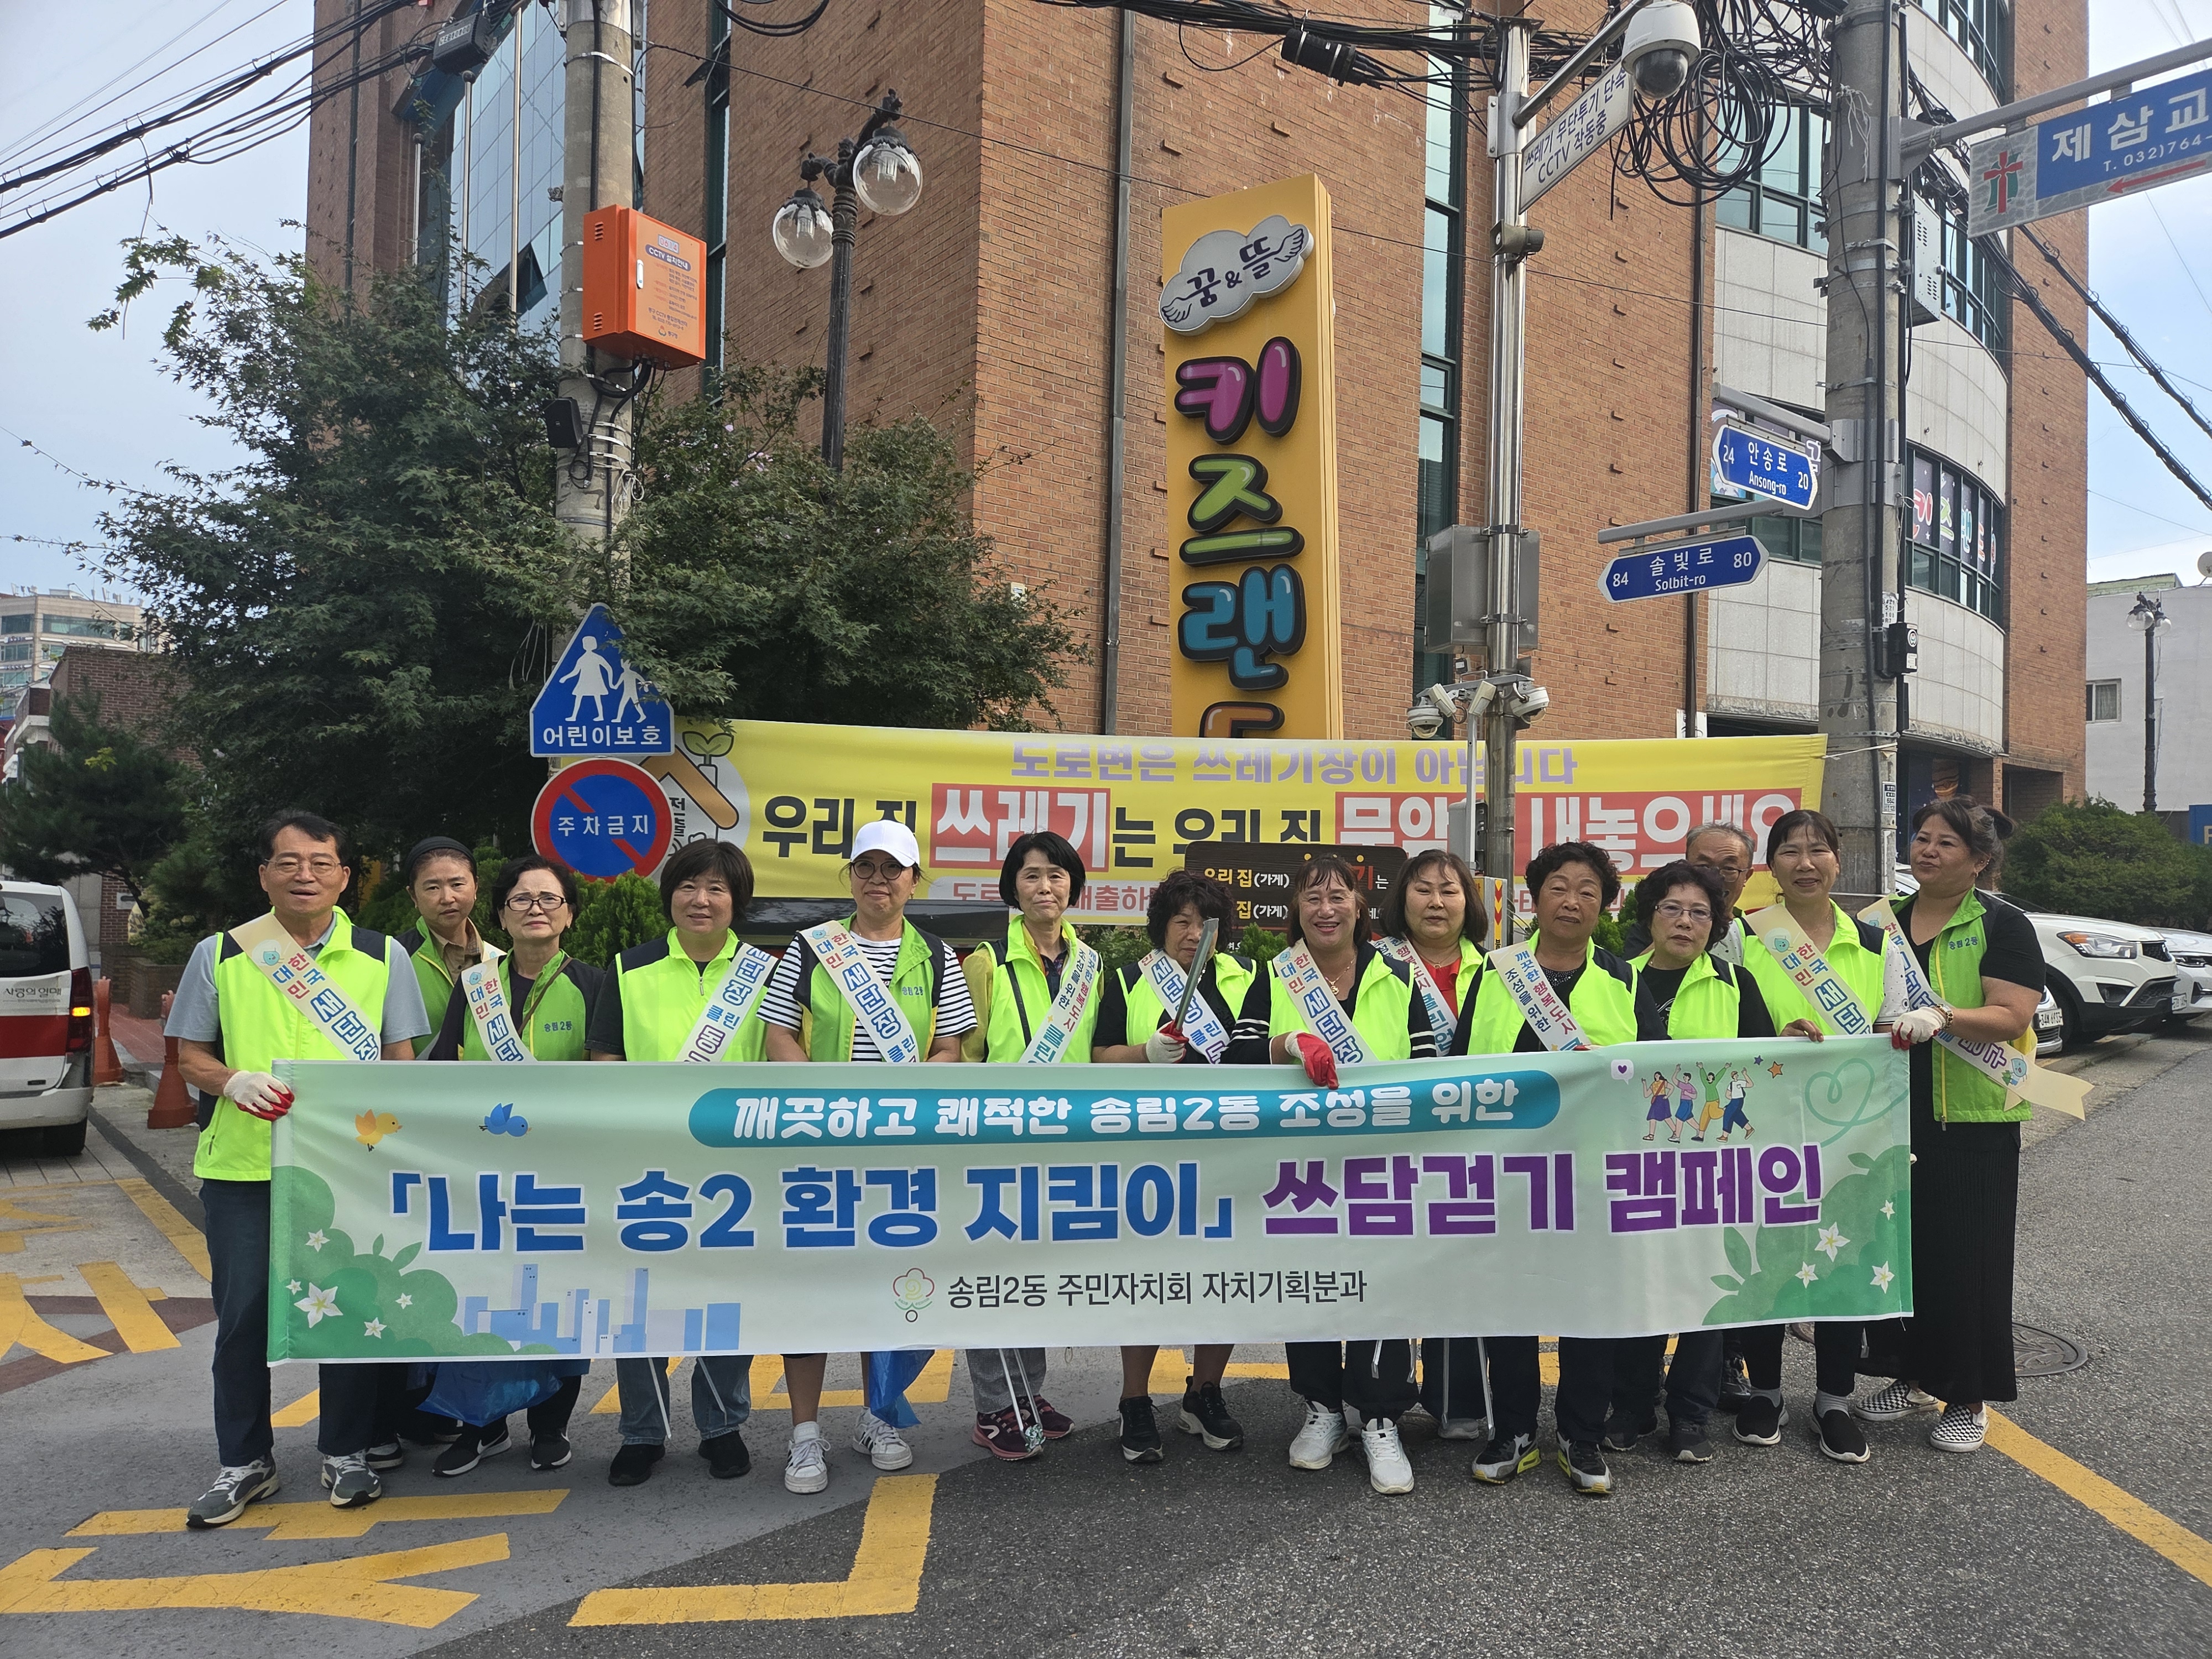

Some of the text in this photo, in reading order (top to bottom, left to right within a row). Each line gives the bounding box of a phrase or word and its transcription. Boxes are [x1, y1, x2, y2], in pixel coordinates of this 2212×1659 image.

[1525, 66, 1627, 173] 쓰레기 무단투기 단속
[1538, 109, 1607, 184] CCTV 작동중
[649, 247, 665, 259] CCTV
[1723, 445, 1735, 465] 24
[1748, 442, 1787, 472] 안송로
[1749, 470, 1787, 495] Ansong-ro
[1798, 471, 1809, 490] 20
[1650, 547, 1715, 577] 솔빛로
[1733, 551, 1753, 569] 80
[1612, 571, 1629, 588] 84
[1655, 573, 1707, 592] Solbit-ro
[543, 724, 662, 748] 어린이보호
[1011, 741, 1177, 781] 도로변은
[1193, 744, 1397, 785] 쓰레기장이
[557, 815, 649, 837] 주차금지
[1504, 967, 1551, 1032] 조성을 위한
[1515, 950, 1540, 983] 깨끗한
[1532, 980, 1577, 1035] 행복도시
[1027, 1023, 1066, 1063] 클린
[733, 1079, 1519, 1139] 깨끗하고 쾌적한 송림2동 조성을 위한
[617, 1169, 756, 1251] 송2
[781, 1166, 939, 1249] 환경
[964, 1161, 1234, 1242] 지킴이」
[1263, 1150, 1576, 1237] 쓰담걷기
[1604, 1143, 1822, 1234] 캠페인
[947, 1270, 1368, 1308] 송림2동 주민자치회 자치기획분과
